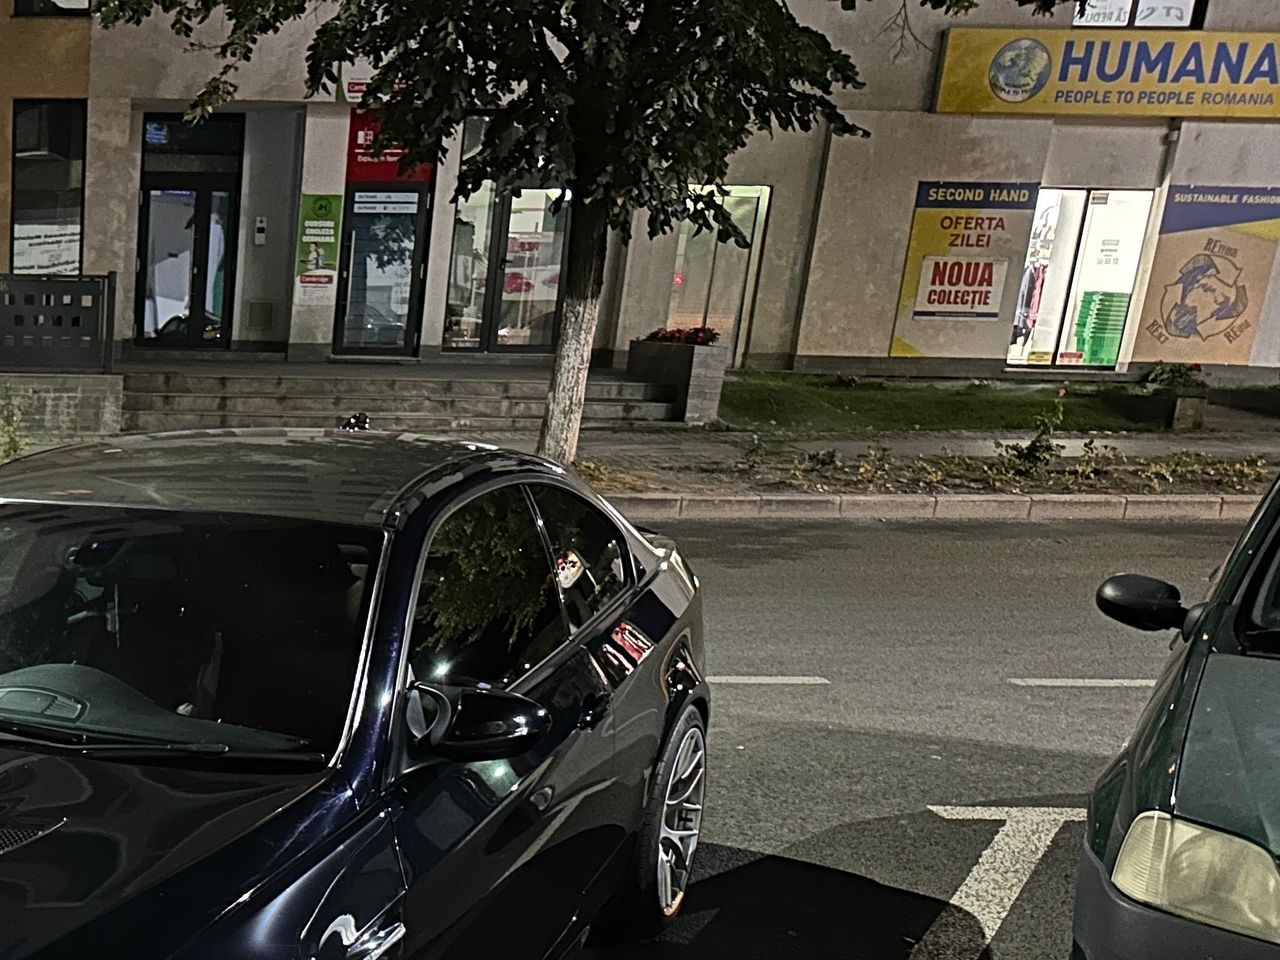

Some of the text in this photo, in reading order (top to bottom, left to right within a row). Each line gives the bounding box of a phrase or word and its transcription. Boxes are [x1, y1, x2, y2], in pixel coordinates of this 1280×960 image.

[1057, 40, 1279, 85] HUMANA
[1054, 89, 1274, 106] PEOPLE TO PEOPLE ROMANIA
[928, 188, 1029, 202] SECOND HAND
[1174, 193, 1239, 204] SUSTAINABLE
[940, 216, 1005, 231] OFERTA
[948, 233, 992, 248] ZILEI
[930, 261, 994, 287] NOUA
